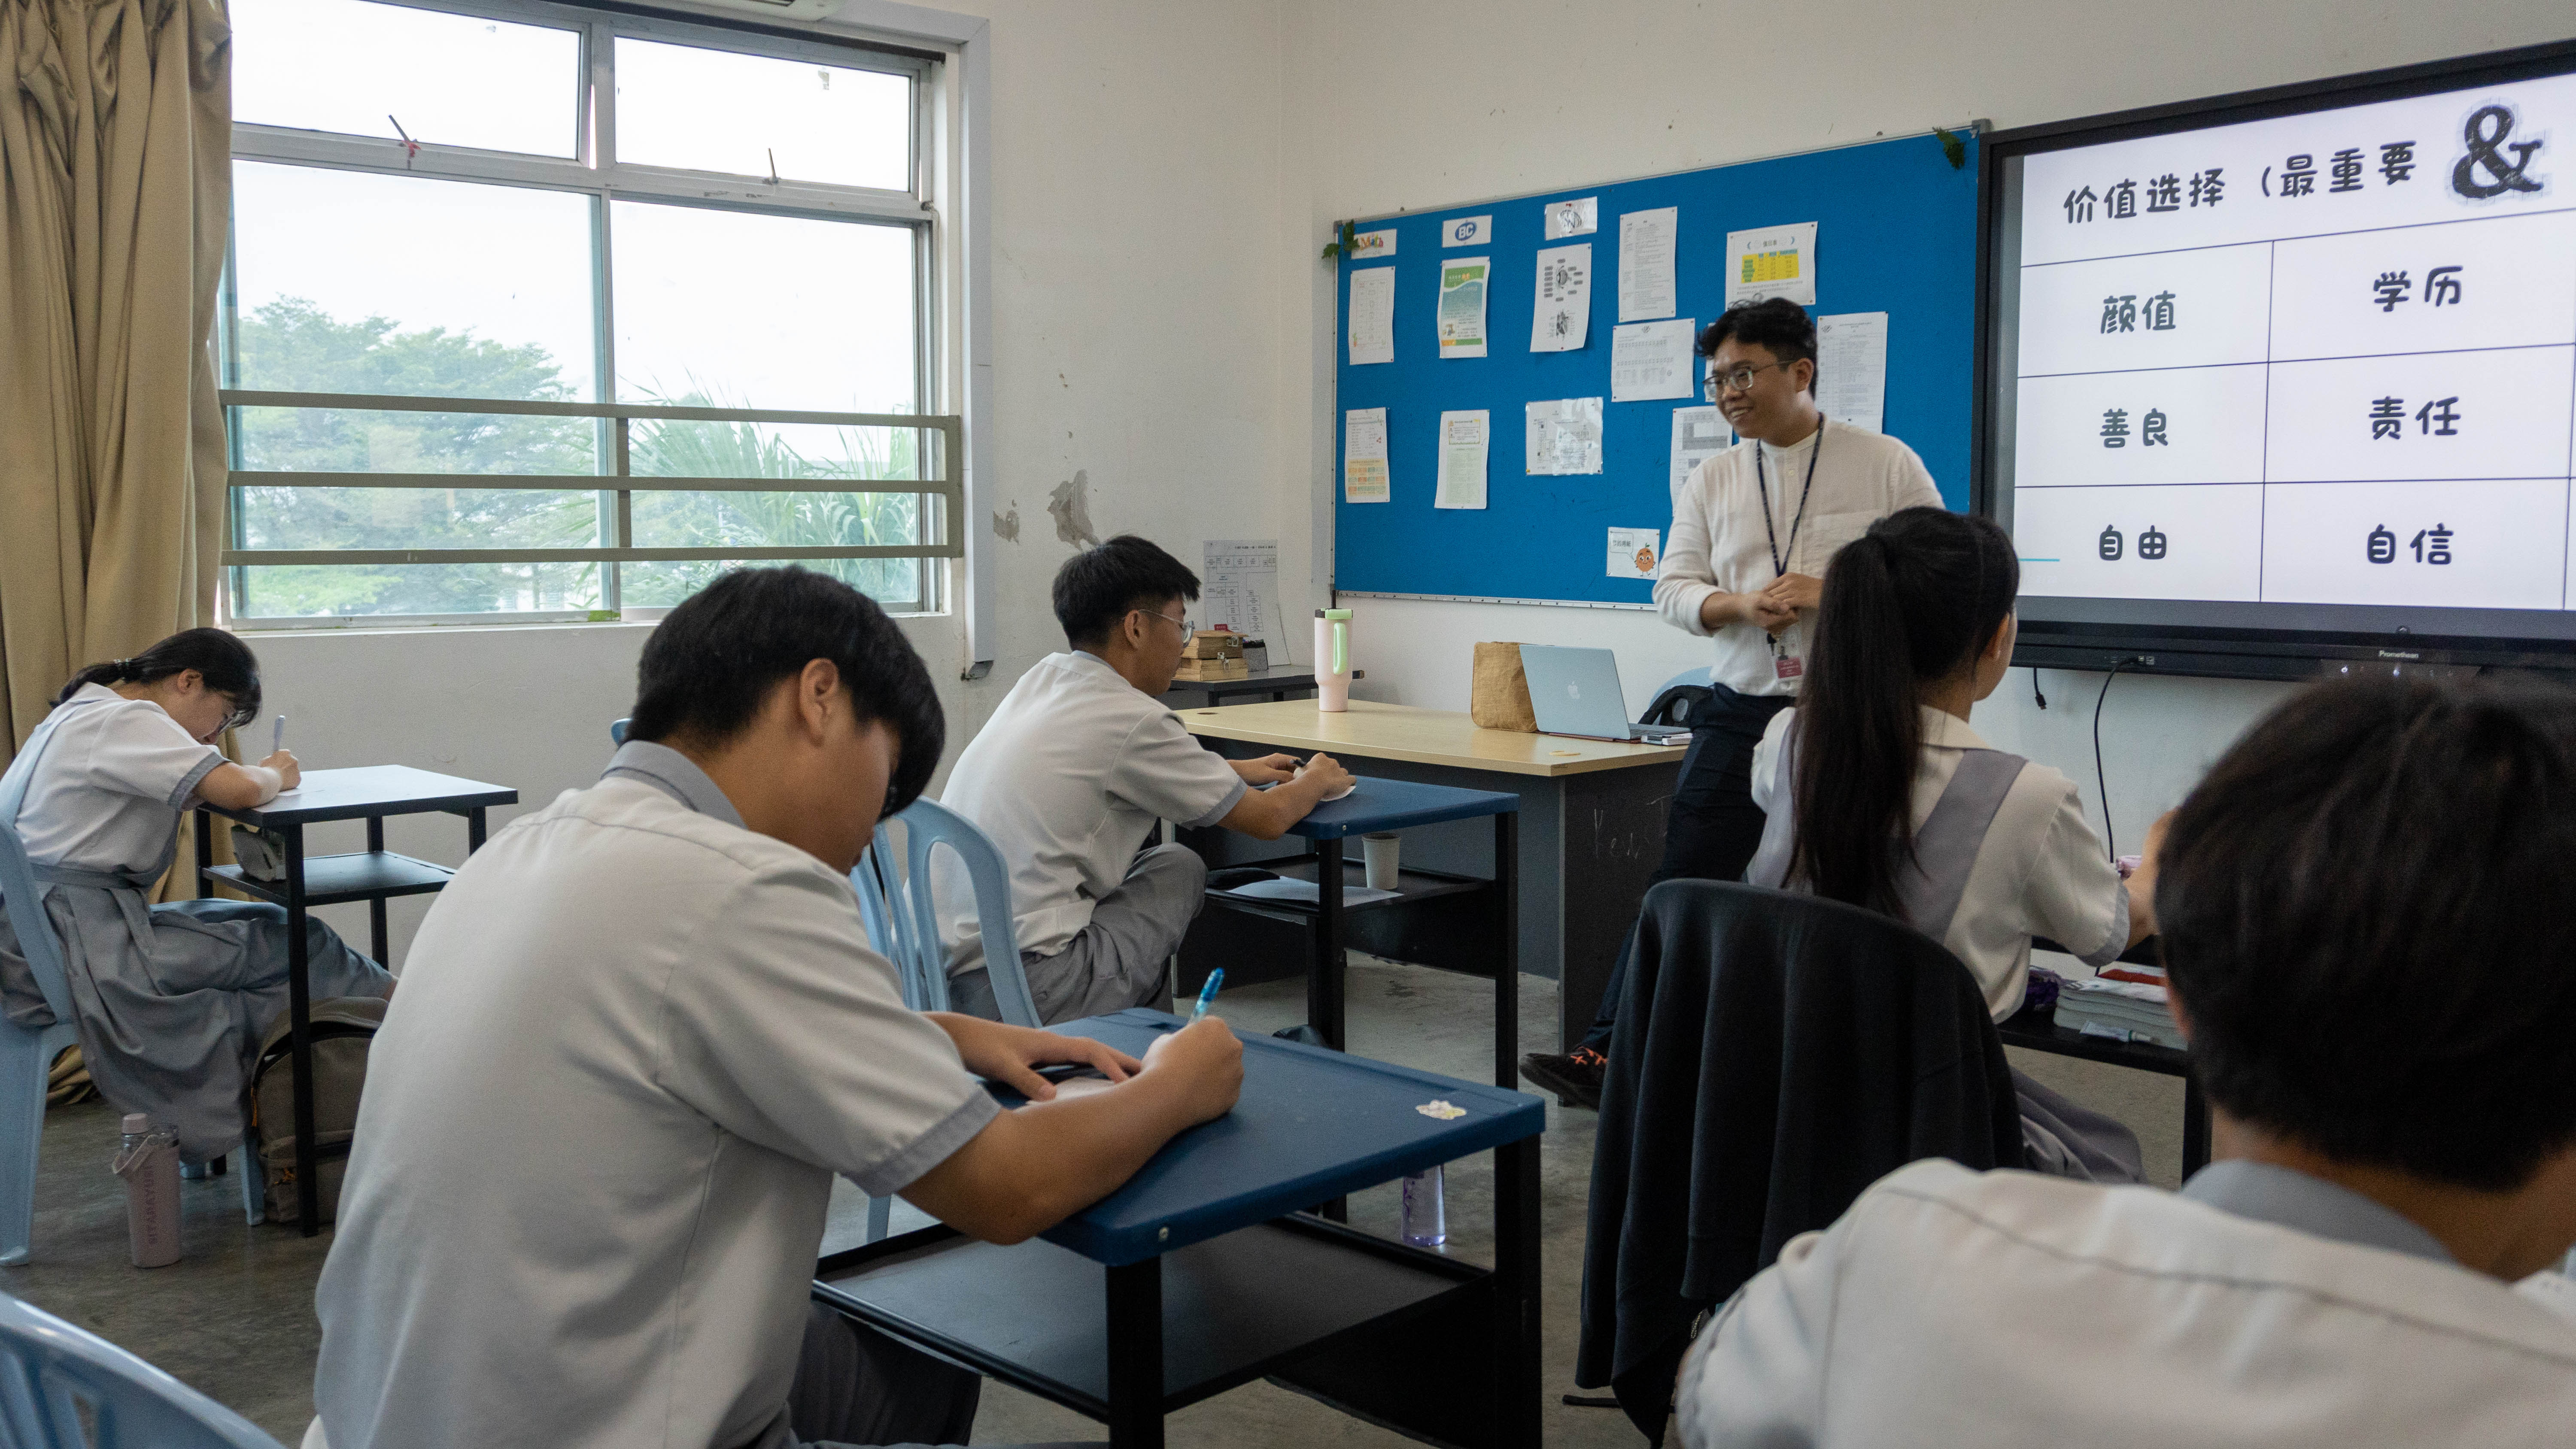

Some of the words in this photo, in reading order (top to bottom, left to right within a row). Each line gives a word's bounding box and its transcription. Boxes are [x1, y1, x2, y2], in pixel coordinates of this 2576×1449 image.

[2452, 106, 2543, 200] &
[2374, 267, 2462, 312] 学历
[2101, 291, 2175, 333] 颜值
[2100, 409, 2168, 448] 善良
[2369, 397, 2460, 440] 责任
[2099, 525, 2166, 561] 自由
[2367, 523, 2453, 565] 自信
